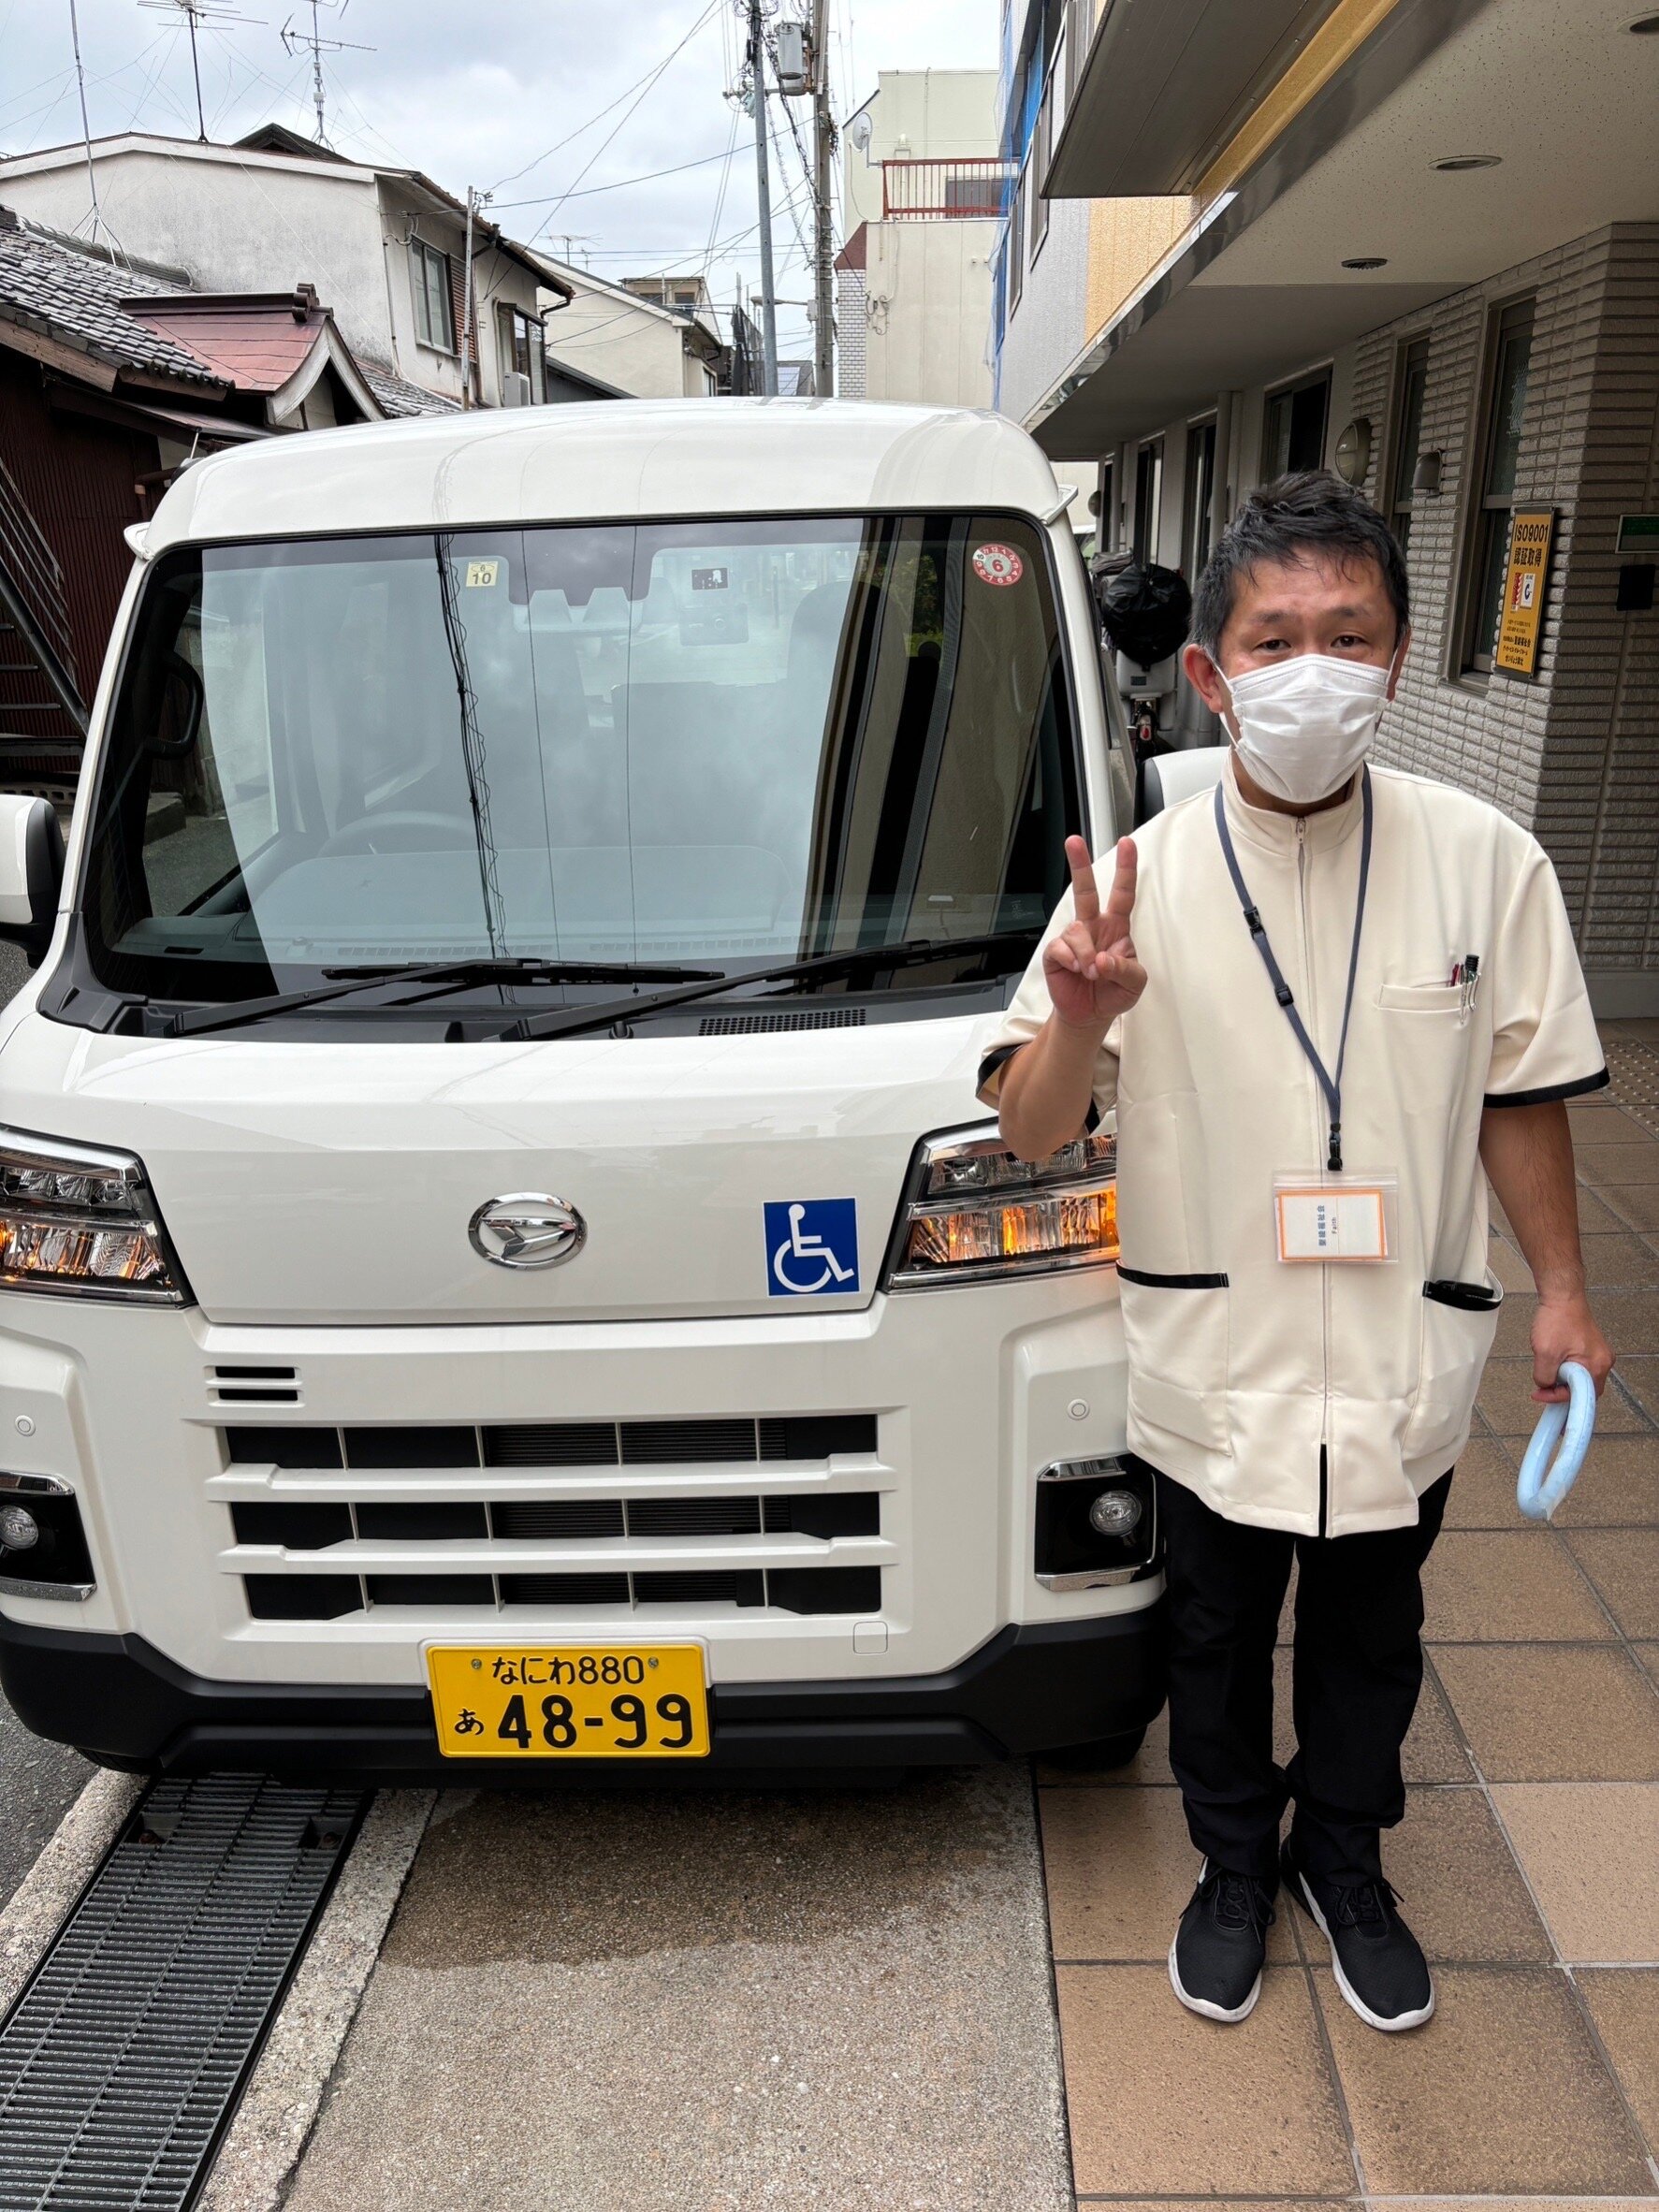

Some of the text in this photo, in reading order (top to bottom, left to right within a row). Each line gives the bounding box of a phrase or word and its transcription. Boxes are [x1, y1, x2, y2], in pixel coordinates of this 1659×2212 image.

[1514, 524, 1549, 543] ISO9001
[992, 559, 1004, 573] 6
[1514, 547, 1542, 567] 認証取得
[473, 572, 491, 585] 10
[492, 1655, 645, 1685] なにわ880
[454, 1694, 693, 1749] あ 48-99
